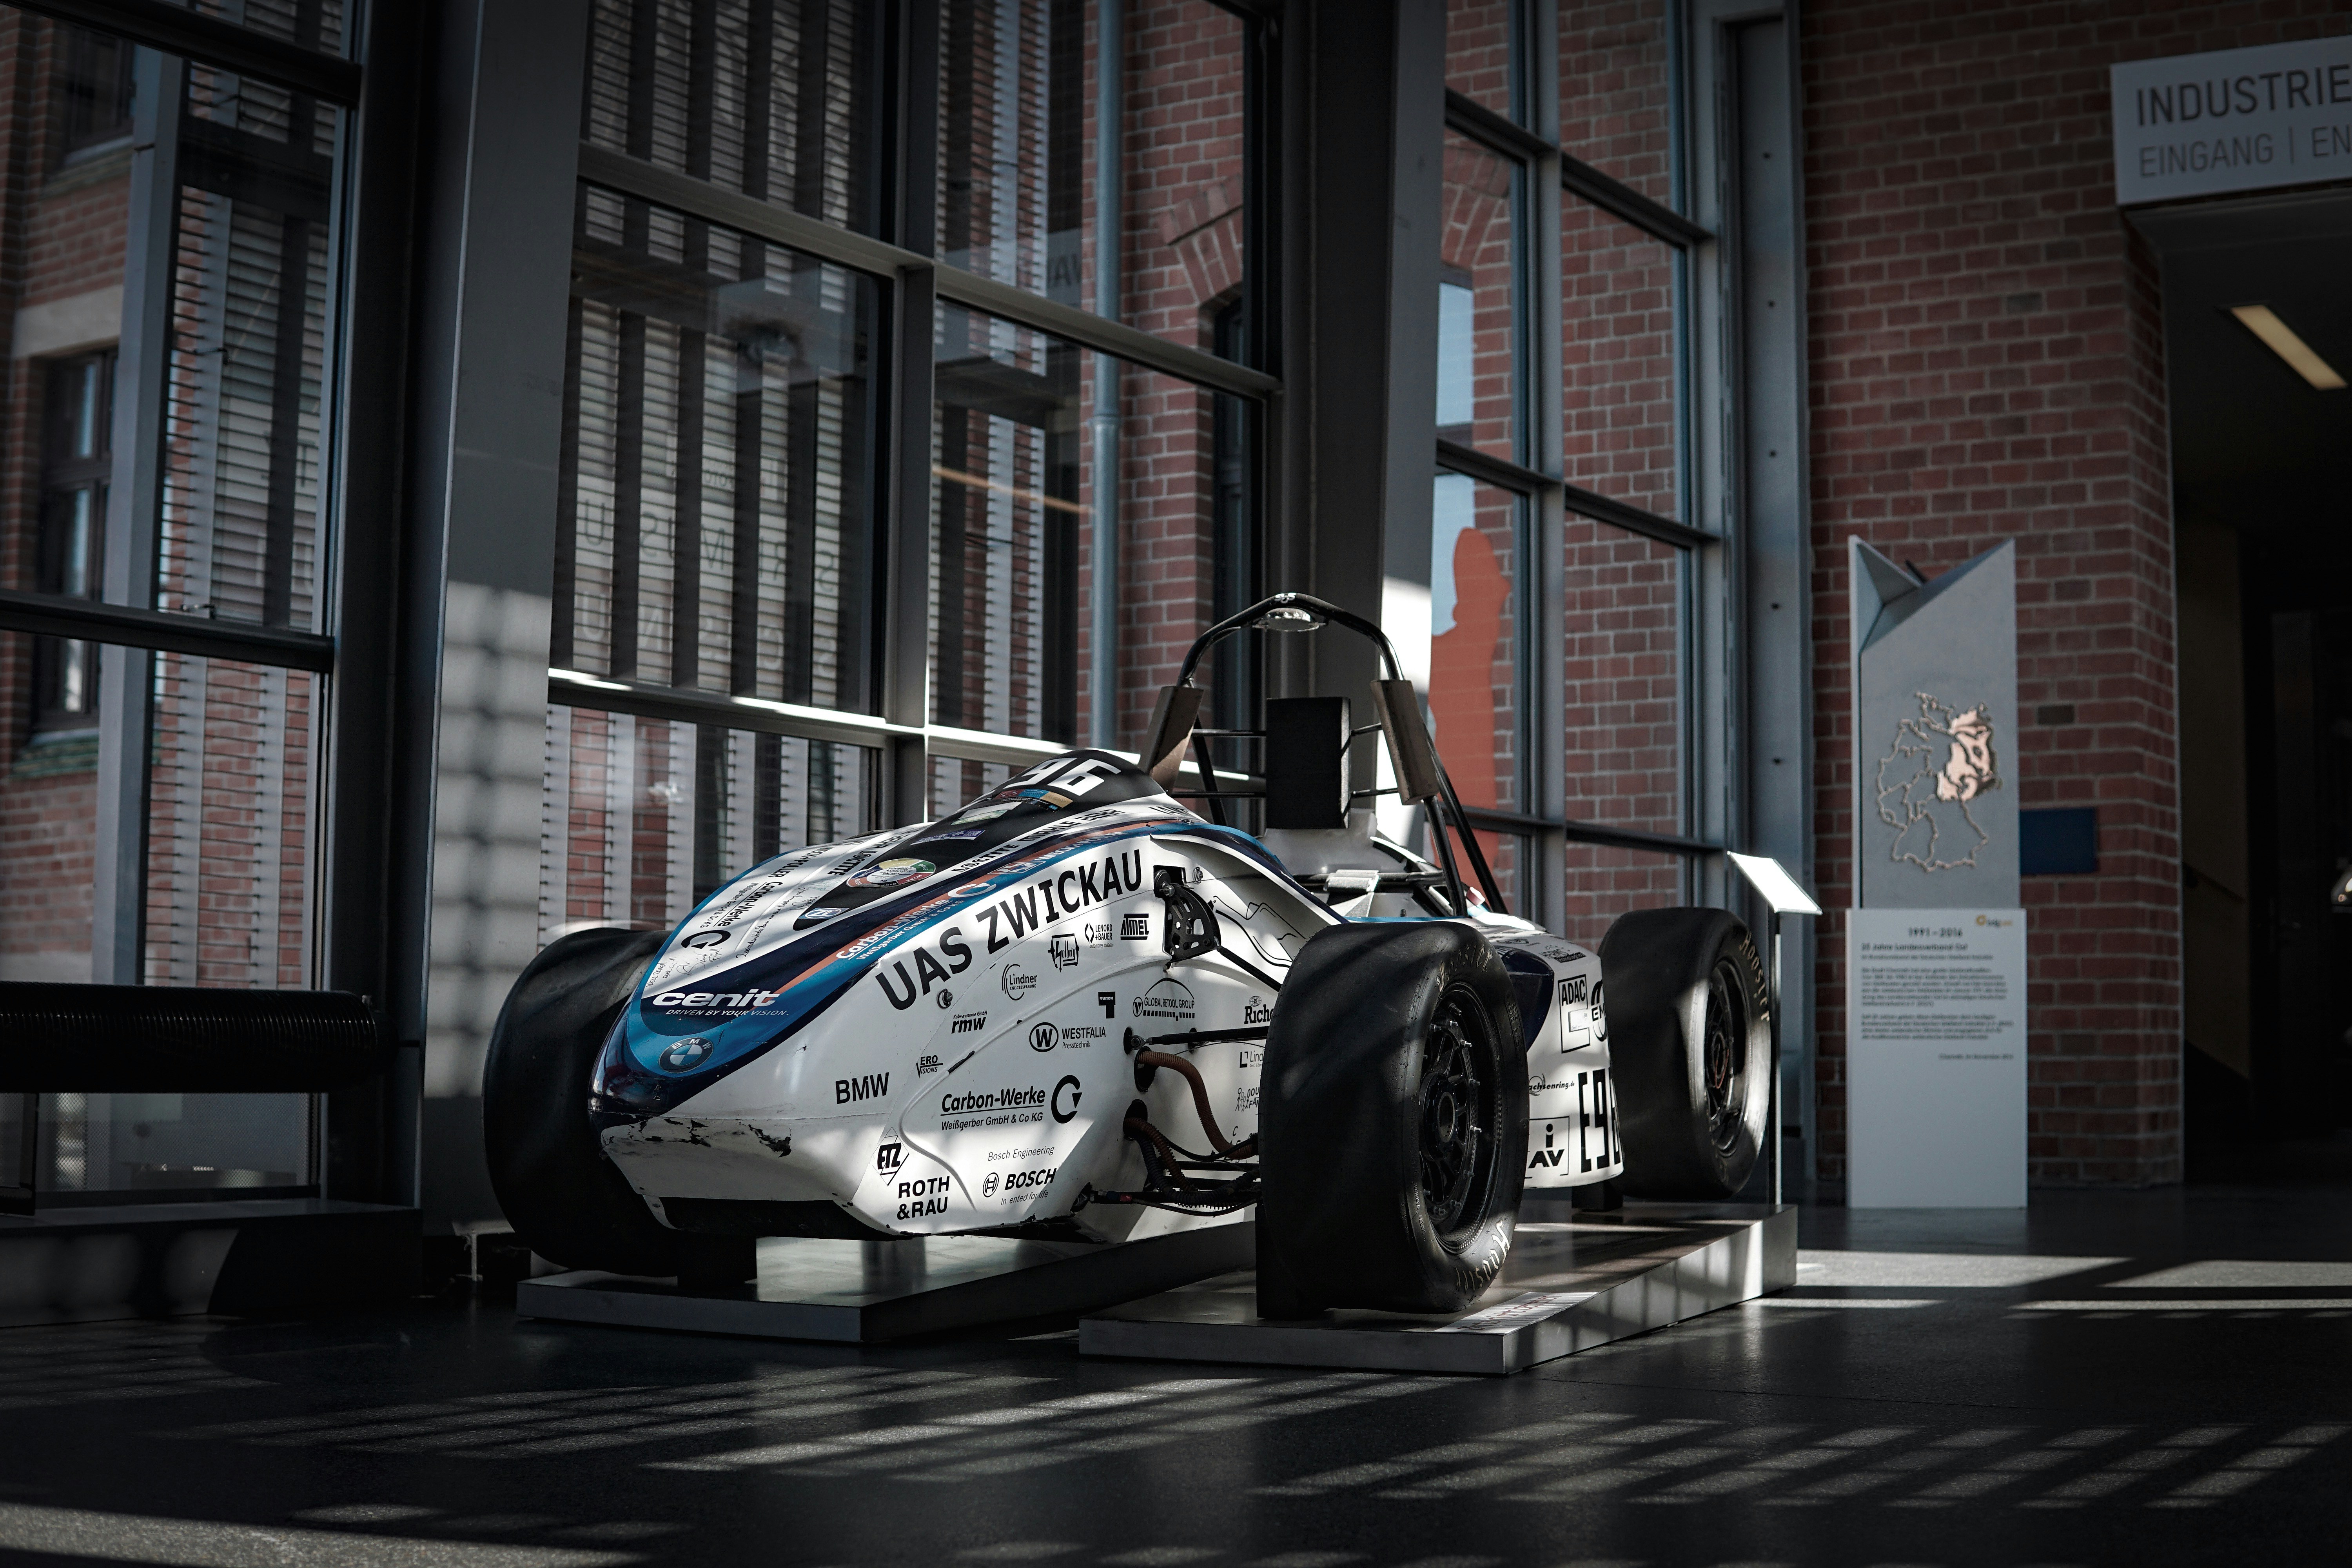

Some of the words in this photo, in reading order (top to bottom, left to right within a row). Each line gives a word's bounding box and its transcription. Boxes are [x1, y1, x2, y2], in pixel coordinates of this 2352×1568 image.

[2136, 63, 2352, 126] INDUSTRIE
[2139, 133, 2273, 178] EINGANG
[952, 843, 1020, 872] LOCTITE
[1017, 820, 1079, 842] MAHLE
[1080, 809, 1127, 821] BEHR
[828, 850, 878, 876] LOCTITE
[718, 881, 783, 927] Carbon-Werke
[836, 899, 949, 959] Carbon-Werke
[875, 926, 973, 1011] UAS
[976, 849, 1142, 955] ZWICKAU
[1095, 924, 1113, 932] LENORD
[1095, 932, 1113, 940] +BAUER
[1120, 916, 1149, 936] ATMEL
[856, 930, 905, 960] Weißgerber
[903, 916, 932, 931] GmbH
[1009, 973, 1038, 985] Lindner
[653, 989, 781, 1007] cenit
[1144, 997, 1163, 1007] GLOBAL
[1163, 998, 1178, 1008] RETOOL
[1178, 999, 1195, 1009] GROUP
[1561, 979, 1586, 1007] ADAC
[951, 1017, 986, 1034] rmw
[1062, 1026, 1107, 1040] WESTFALIA
[671, 1038, 713, 1051] BMW
[1062, 1040, 1091, 1049] Presstechnik
[835, 1072, 890, 1104] BMW
[1528, 1081, 1575, 1089] achsenring.de
[942, 1085, 1045, 1112] Carbon-Werke
[985, 1115, 1009, 1126] GmbH
[1011, 1114, 1016, 1123] &
[1019, 1113, 1029, 1123] Co
[1031, 1112, 1043, 1122] KG
[877, 1143, 902, 1172] ETZ
[988, 1149, 1011, 1161] Bosch
[1013, 1145, 1055, 1159] Engineering
[898, 1176, 950, 1199] ROTH
[1005, 1168, 1057, 1191] BOSCH
[897, 1196, 949, 1220] &RAU
[1000, 1194, 1027, 1206] Inented
[1028, 1192, 1037, 1202] for
[1037, 1190, 1049, 1200] life
